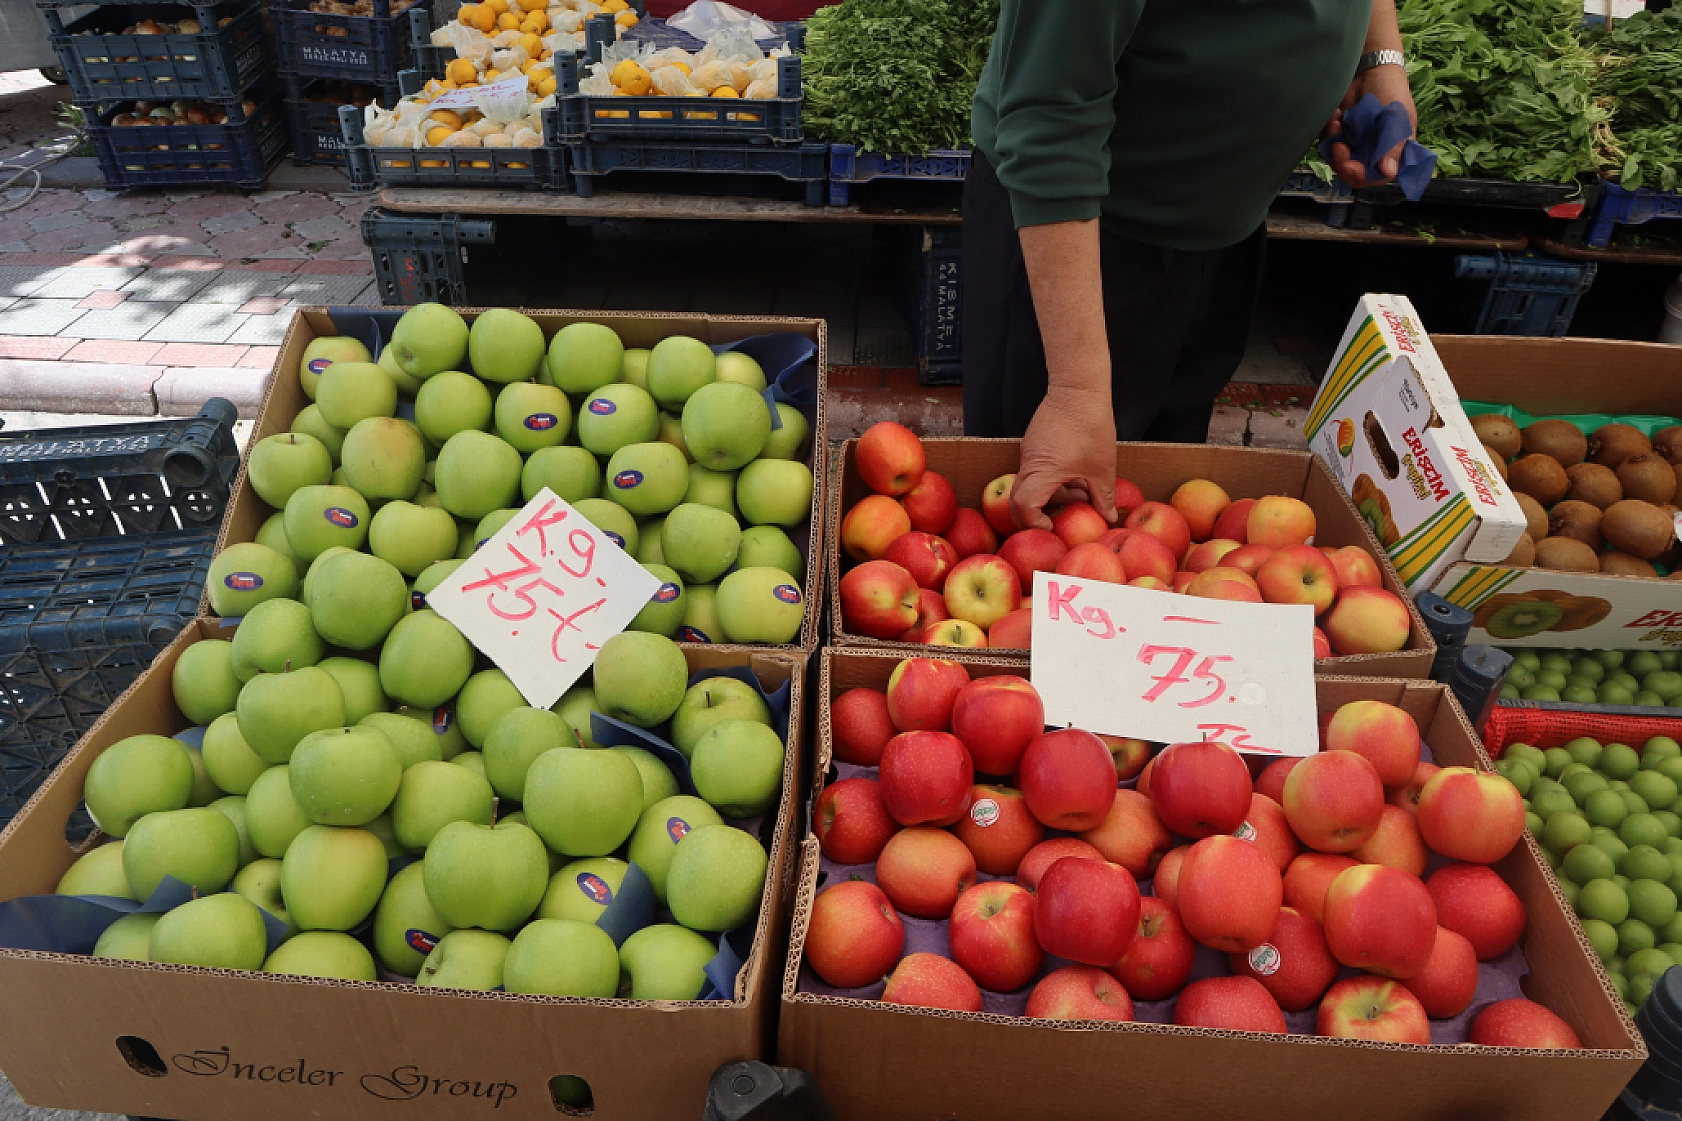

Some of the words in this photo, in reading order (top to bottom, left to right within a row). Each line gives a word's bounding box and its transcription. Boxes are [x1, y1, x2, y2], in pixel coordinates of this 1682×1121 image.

[303, 47, 368, 60] MALATYA
[936, 285, 947, 351] MALATYA
[0, 434, 150, 457] MALATYA
[1047, 580, 1127, 640] Kg.
[359, 1065, 518, 1109] Group
